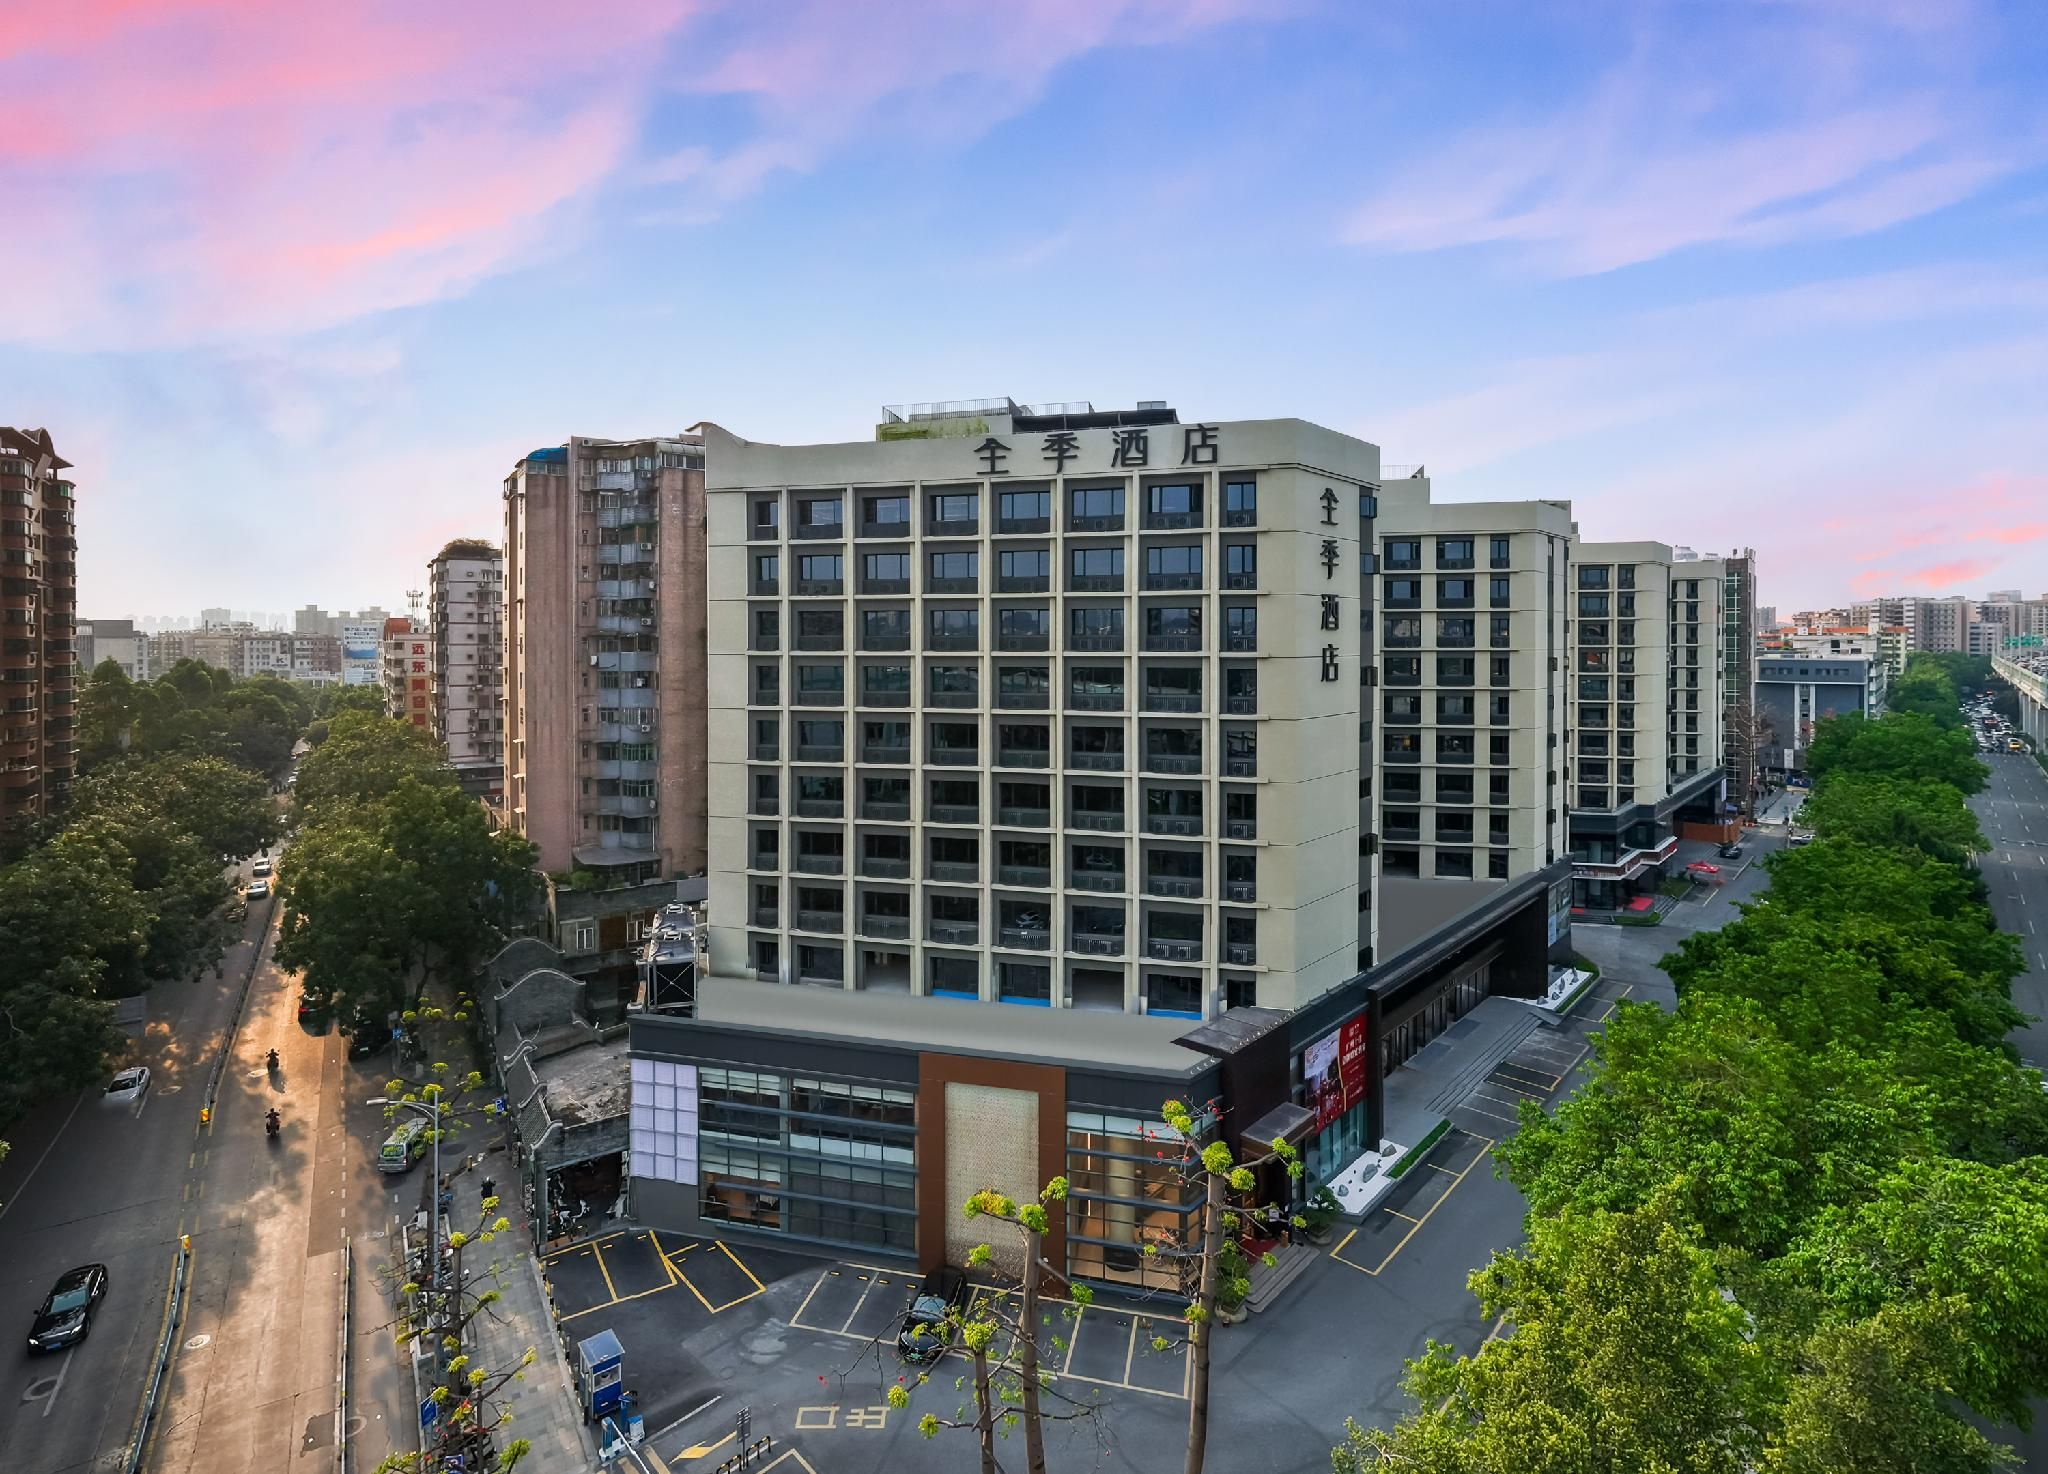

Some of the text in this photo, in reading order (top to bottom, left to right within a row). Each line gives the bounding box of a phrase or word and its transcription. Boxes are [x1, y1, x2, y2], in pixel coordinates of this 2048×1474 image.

[974, 423, 1220, 474] 全季酒店
[1319, 487, 1340, 683] 全季酒店
[795, 1406, 890, 1429] 出口
